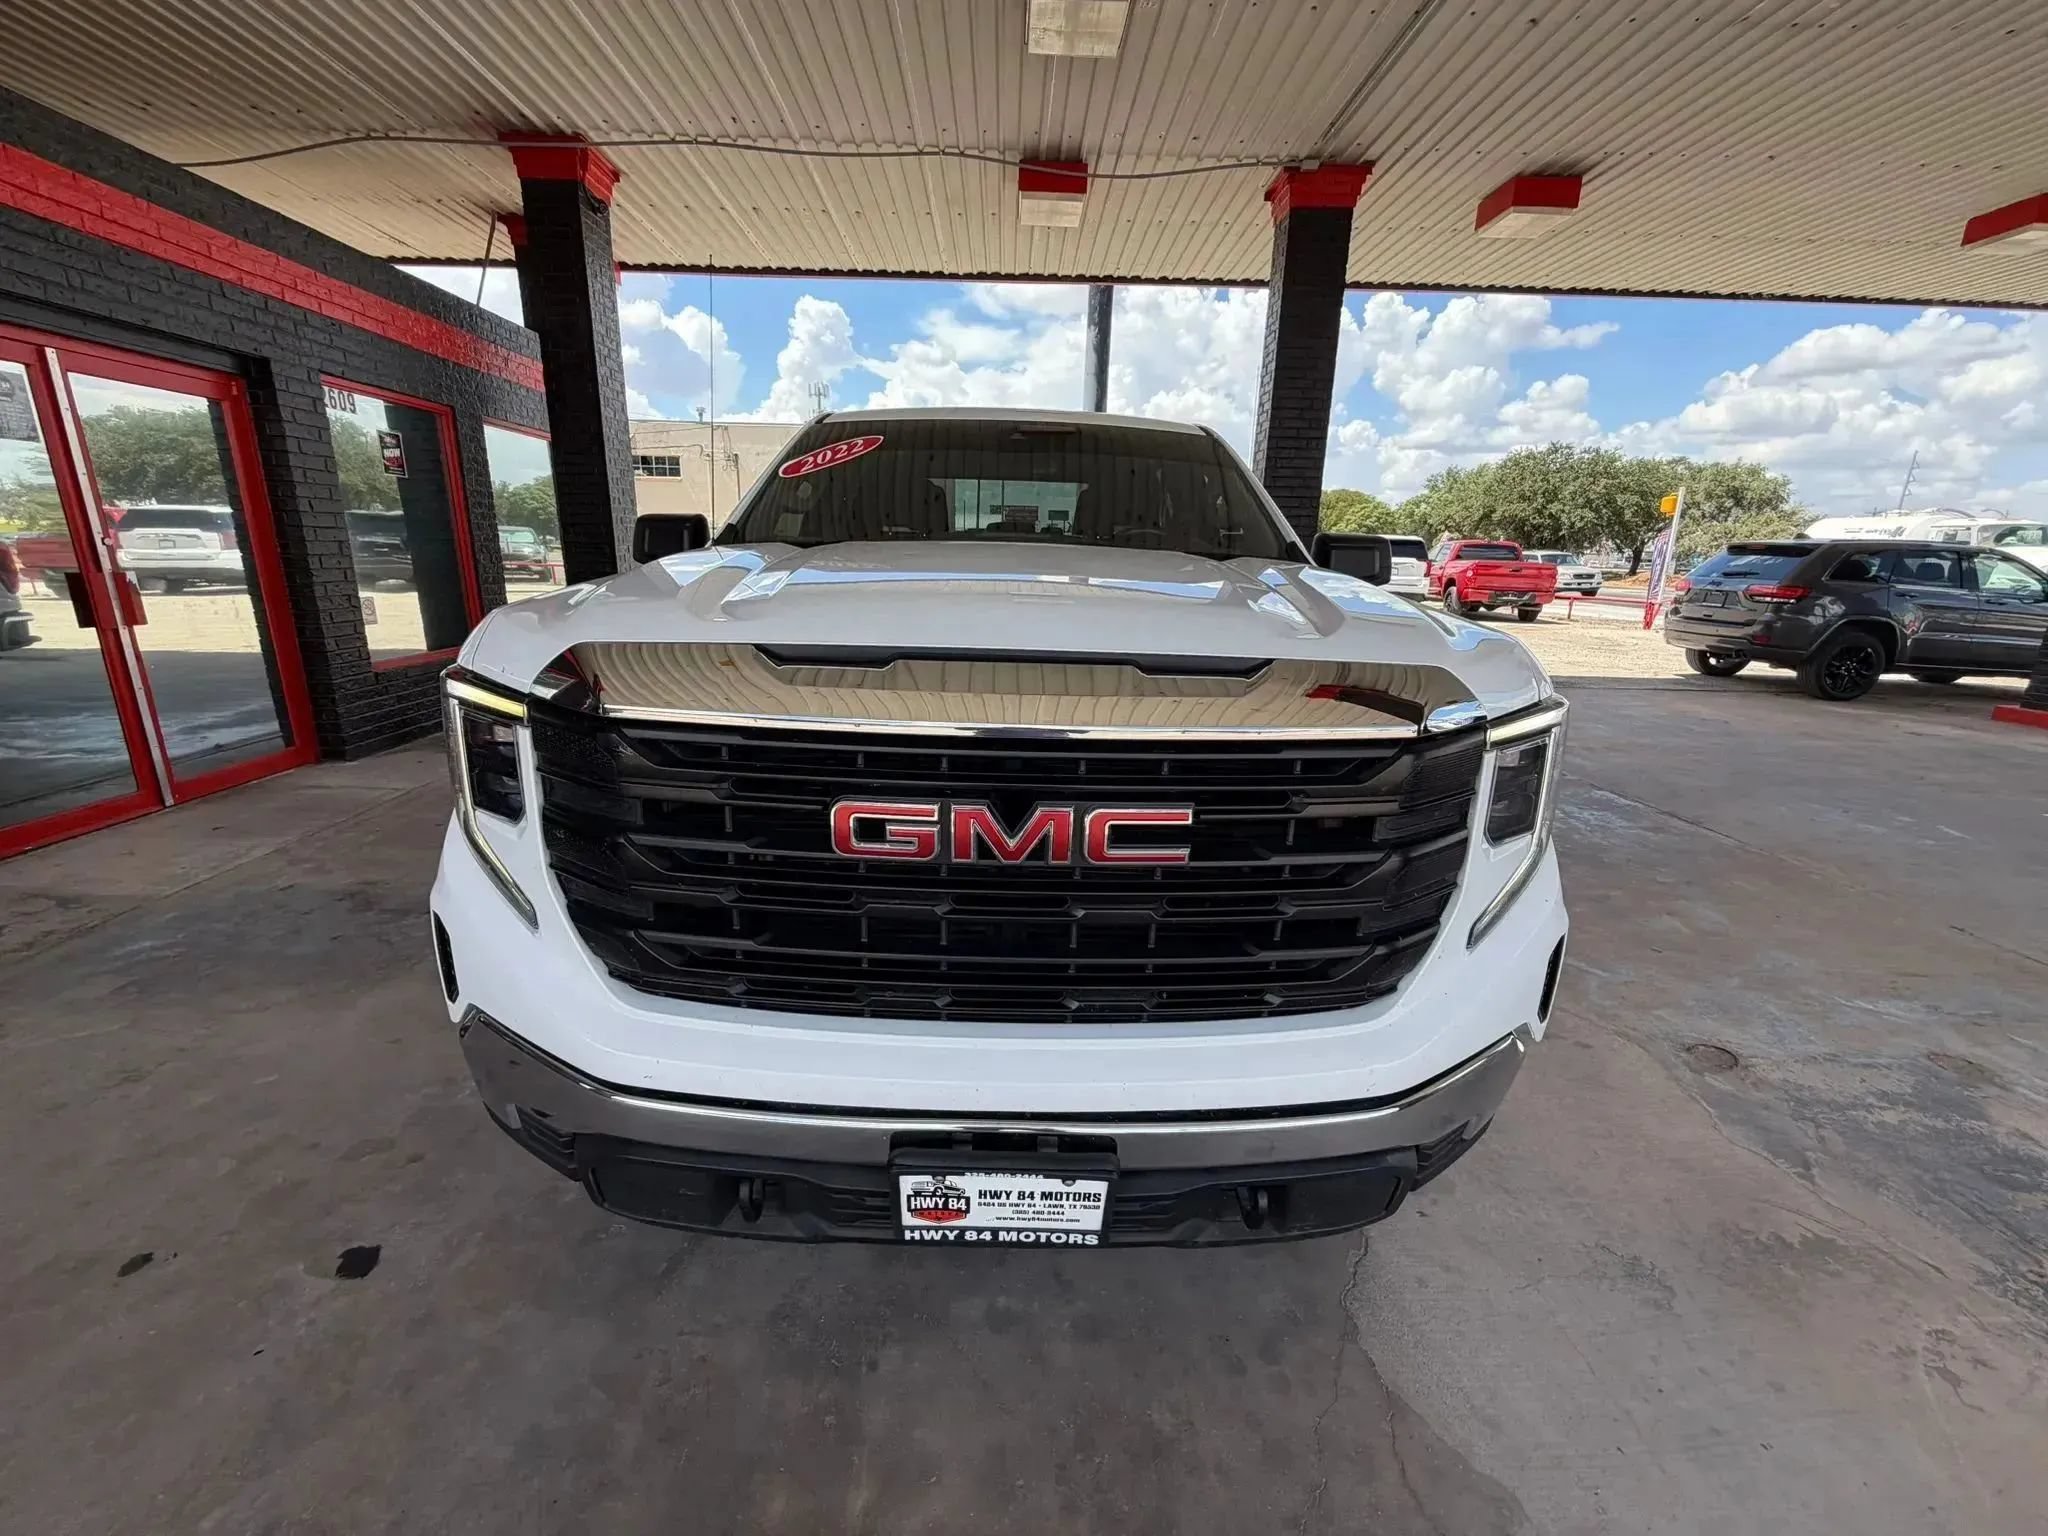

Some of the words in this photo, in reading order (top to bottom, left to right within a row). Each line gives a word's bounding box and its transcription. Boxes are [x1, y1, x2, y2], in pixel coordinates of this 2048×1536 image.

[800, 439, 864, 472] 2022
[831, 800, 1194, 865] GMC
[911, 1196, 945, 1209] HWY
[948, 1198, 967, 1210] 84
[978, 1189, 1013, 1200] HWY
[1017, 1190, 1035, 1201] 84
[1040, 1191, 1102, 1203] MOTORS
[904, 1229, 960, 1241] HWY
[964, 1230, 993, 1241] 84
[998, 1231, 1099, 1245] MOTORS
